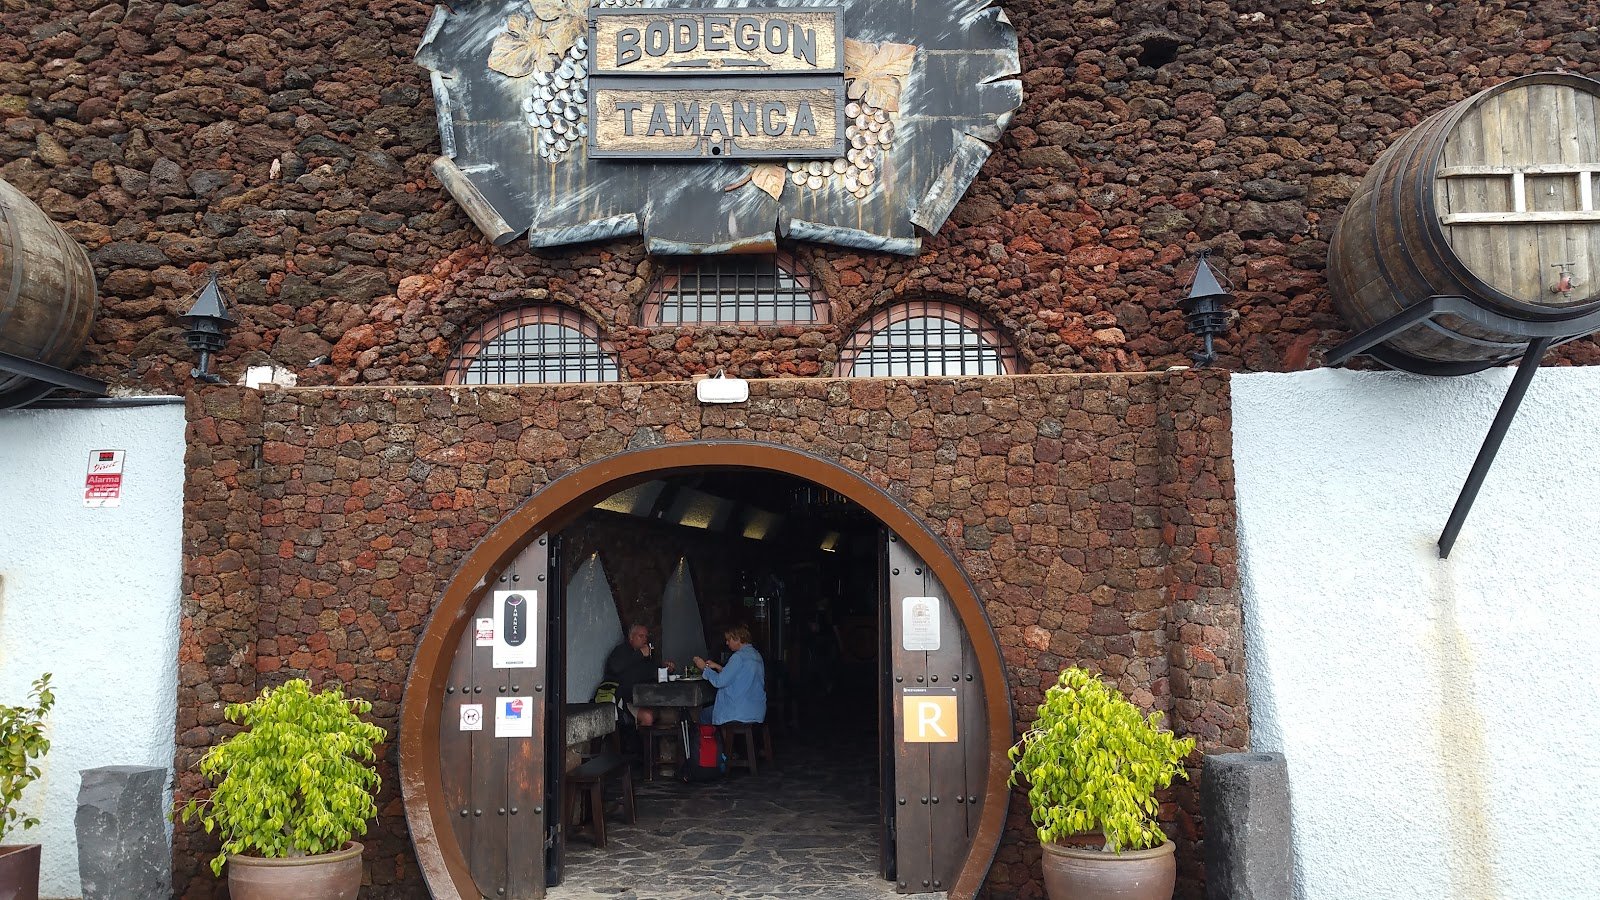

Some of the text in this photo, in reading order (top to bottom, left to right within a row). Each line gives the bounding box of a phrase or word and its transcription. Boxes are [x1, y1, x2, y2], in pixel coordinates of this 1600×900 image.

[616, 18, 817, 67] BODEGON
[616, 101, 816, 137] TAMANCA
[88, 475, 120, 483] Alarma
[918, 701, 947, 737] R
